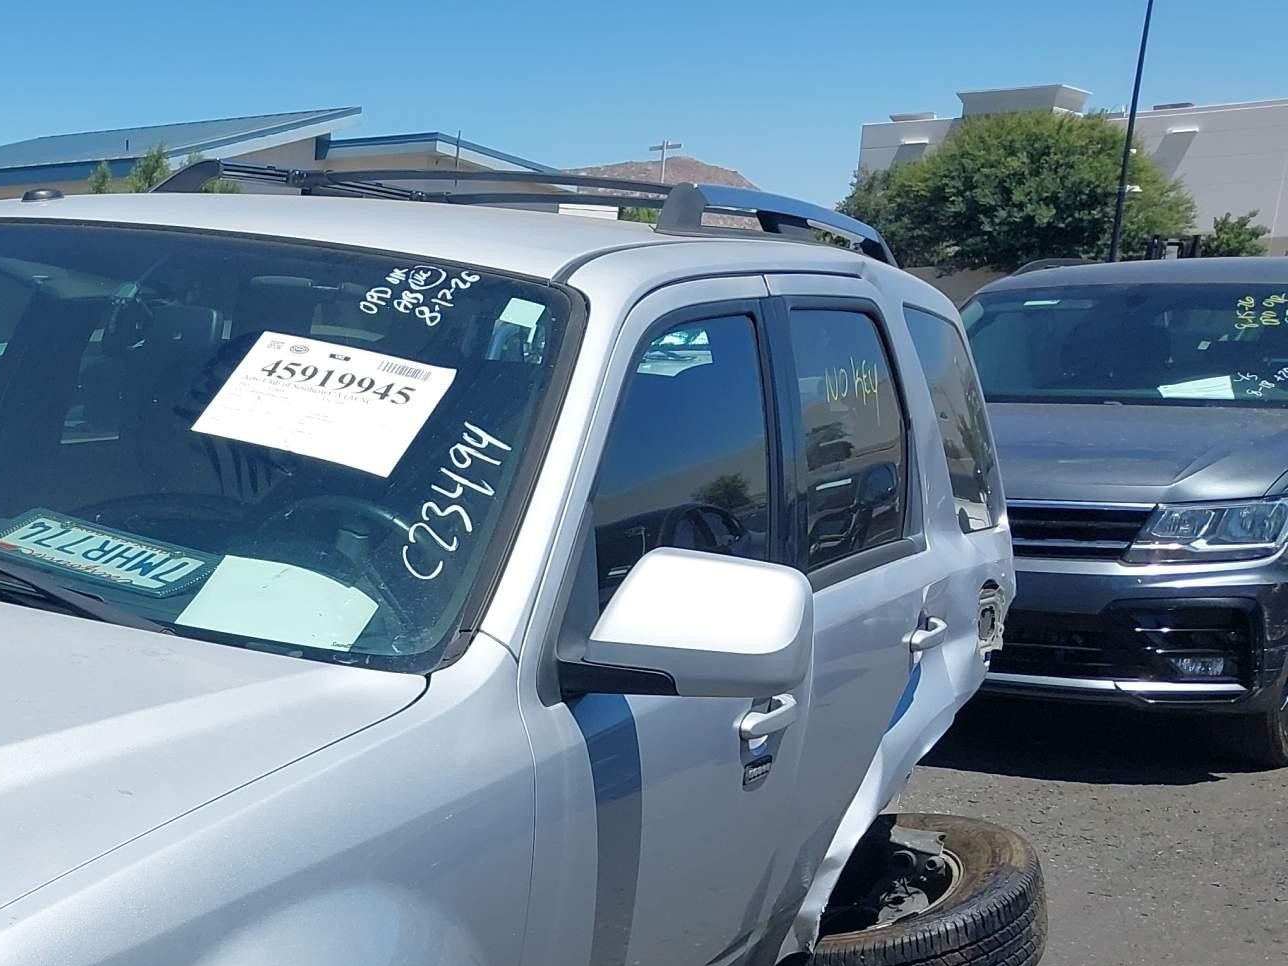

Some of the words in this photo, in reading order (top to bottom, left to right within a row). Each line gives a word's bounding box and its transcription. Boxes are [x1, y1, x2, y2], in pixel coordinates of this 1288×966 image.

[260, 359, 417, 406] 45919945
[825, 366, 849, 404] NO
[402, 420, 512, 581] C23494
